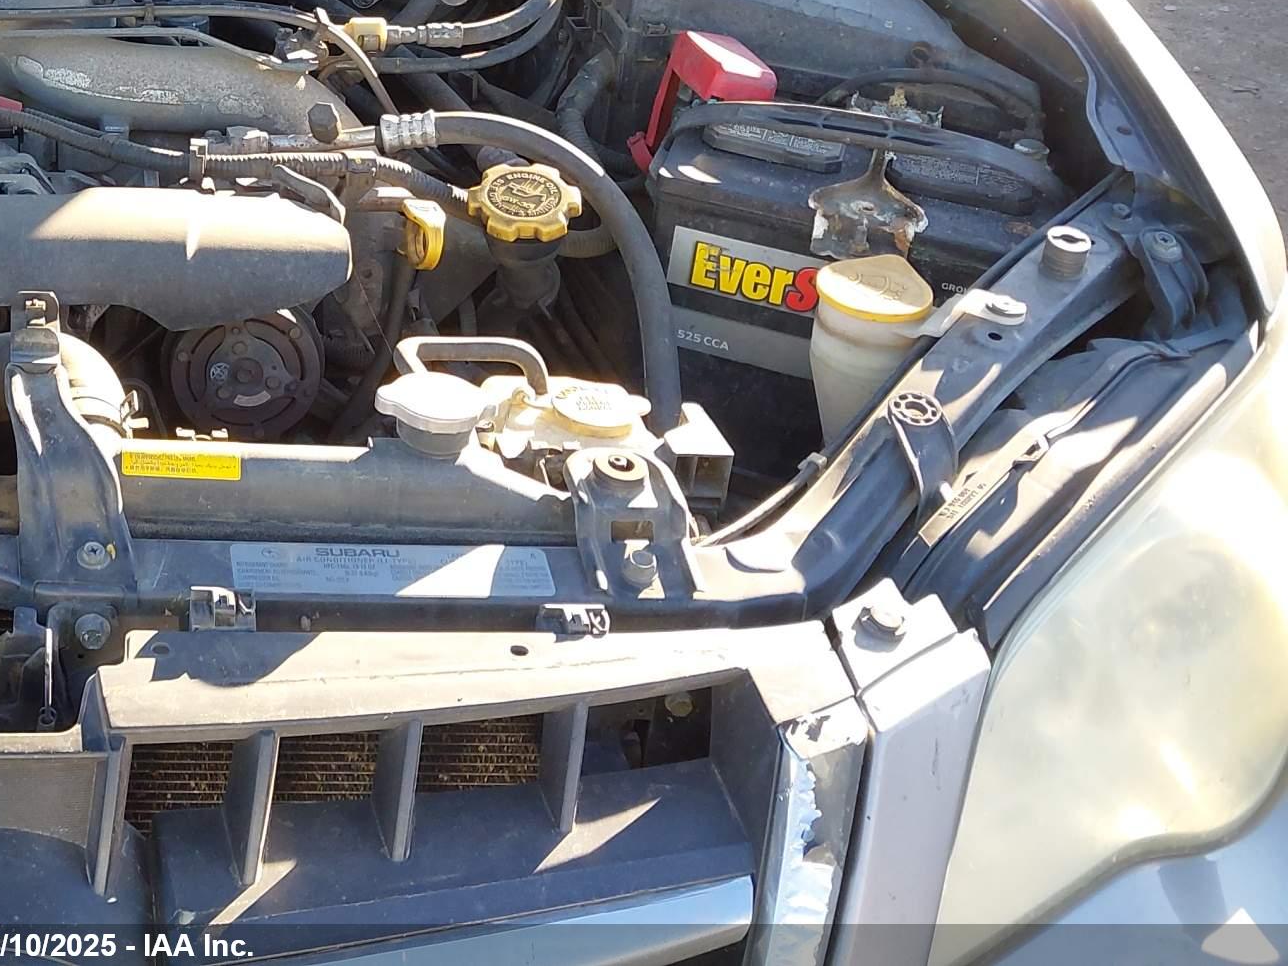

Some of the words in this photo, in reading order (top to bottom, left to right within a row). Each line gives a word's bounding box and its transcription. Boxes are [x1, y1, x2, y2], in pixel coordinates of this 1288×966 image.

[506, 172, 547, 184] ENGINE
[545, 182, 559, 195] OIL
[941, 282, 968, 294] GRO
[677, 329, 702, 344] 525
[703, 336, 729, 351] CCA
[315, 547, 400, 558] SUBARU
